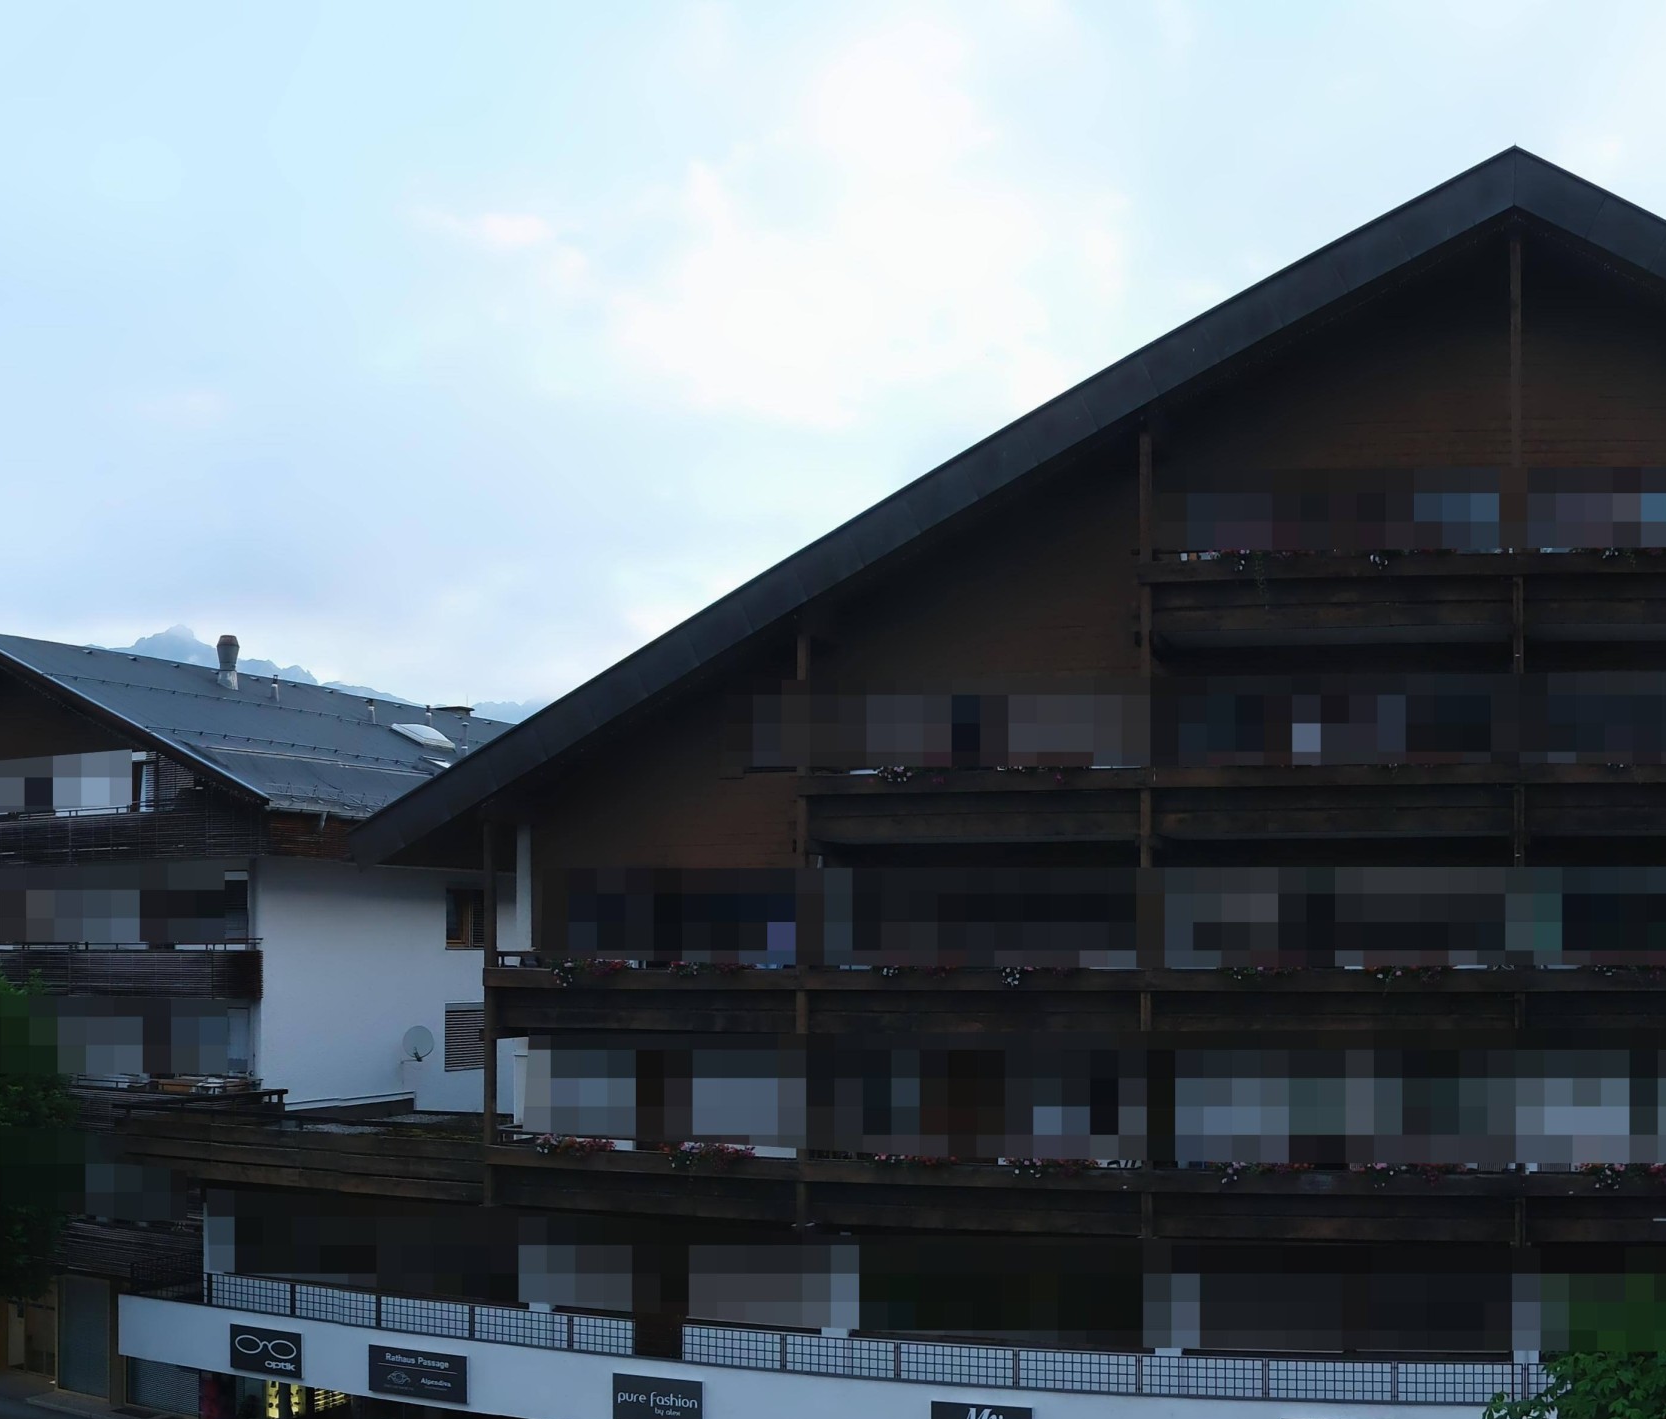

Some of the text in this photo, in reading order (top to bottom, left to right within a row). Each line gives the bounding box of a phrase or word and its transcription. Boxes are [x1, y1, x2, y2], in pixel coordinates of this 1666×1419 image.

[264, 1359, 296, 1373] optik
[385, 1353, 449, 1369] Rathaus Passage
[618, 1392, 697, 1408] pure fashion
[655, 1408, 664, 1416] by
